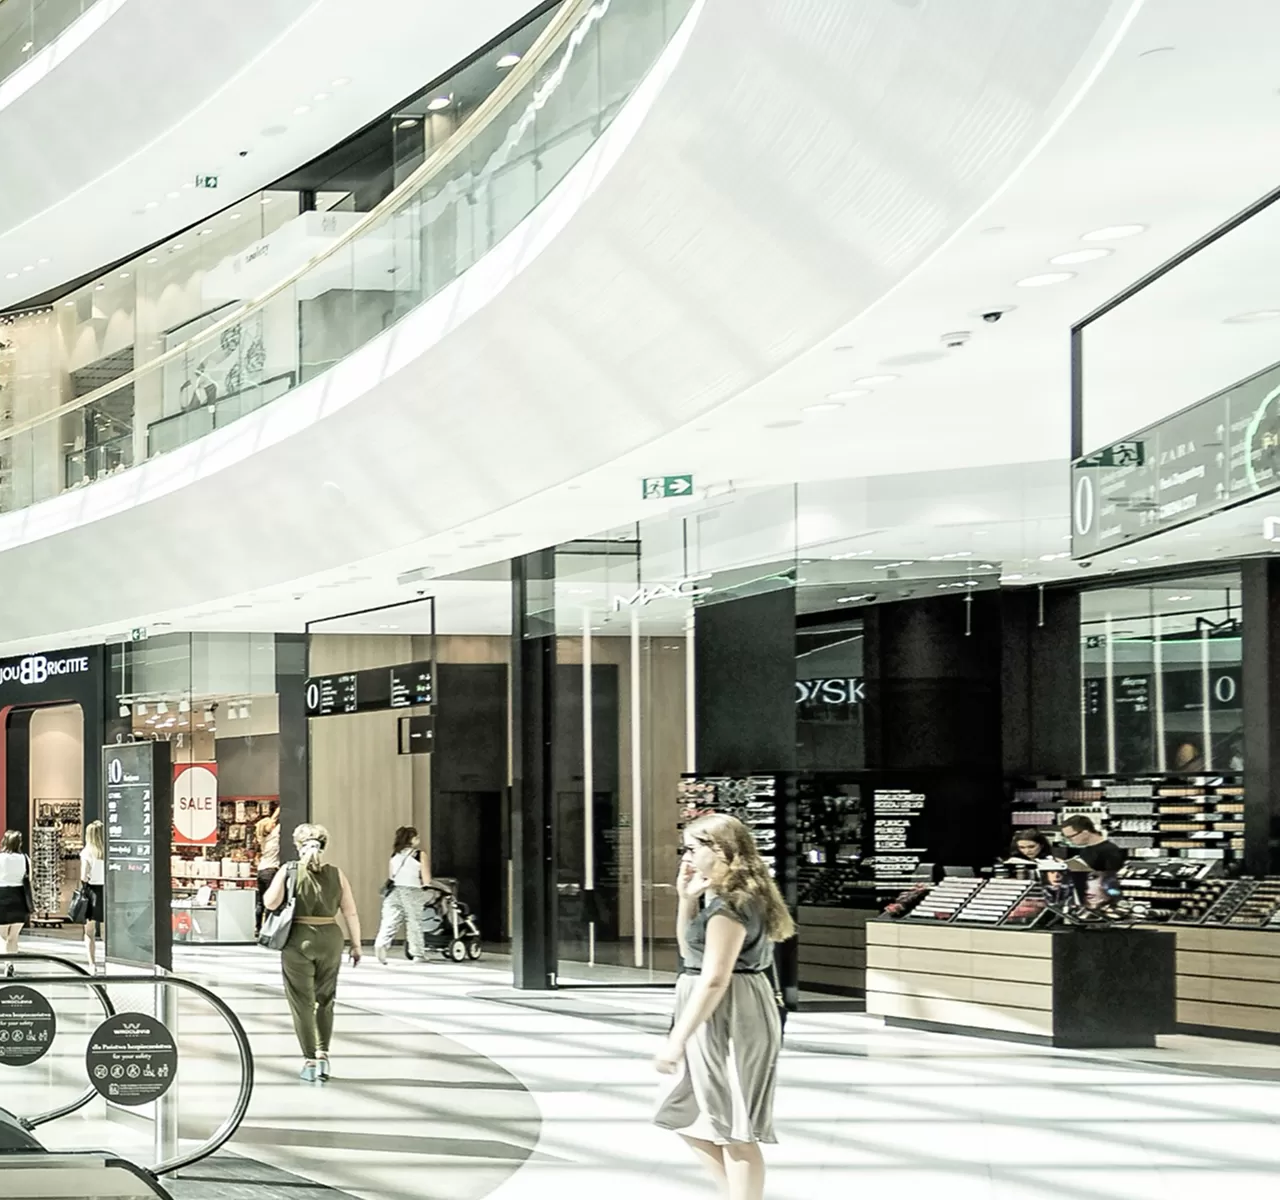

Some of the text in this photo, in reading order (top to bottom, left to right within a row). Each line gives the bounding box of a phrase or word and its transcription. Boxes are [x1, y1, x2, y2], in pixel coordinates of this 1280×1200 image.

[1075, 476, 1094, 535] 0
[306, 684, 319, 709] 0
[111, 758, 122, 783] 0
[179, 796, 212, 811] SALE
